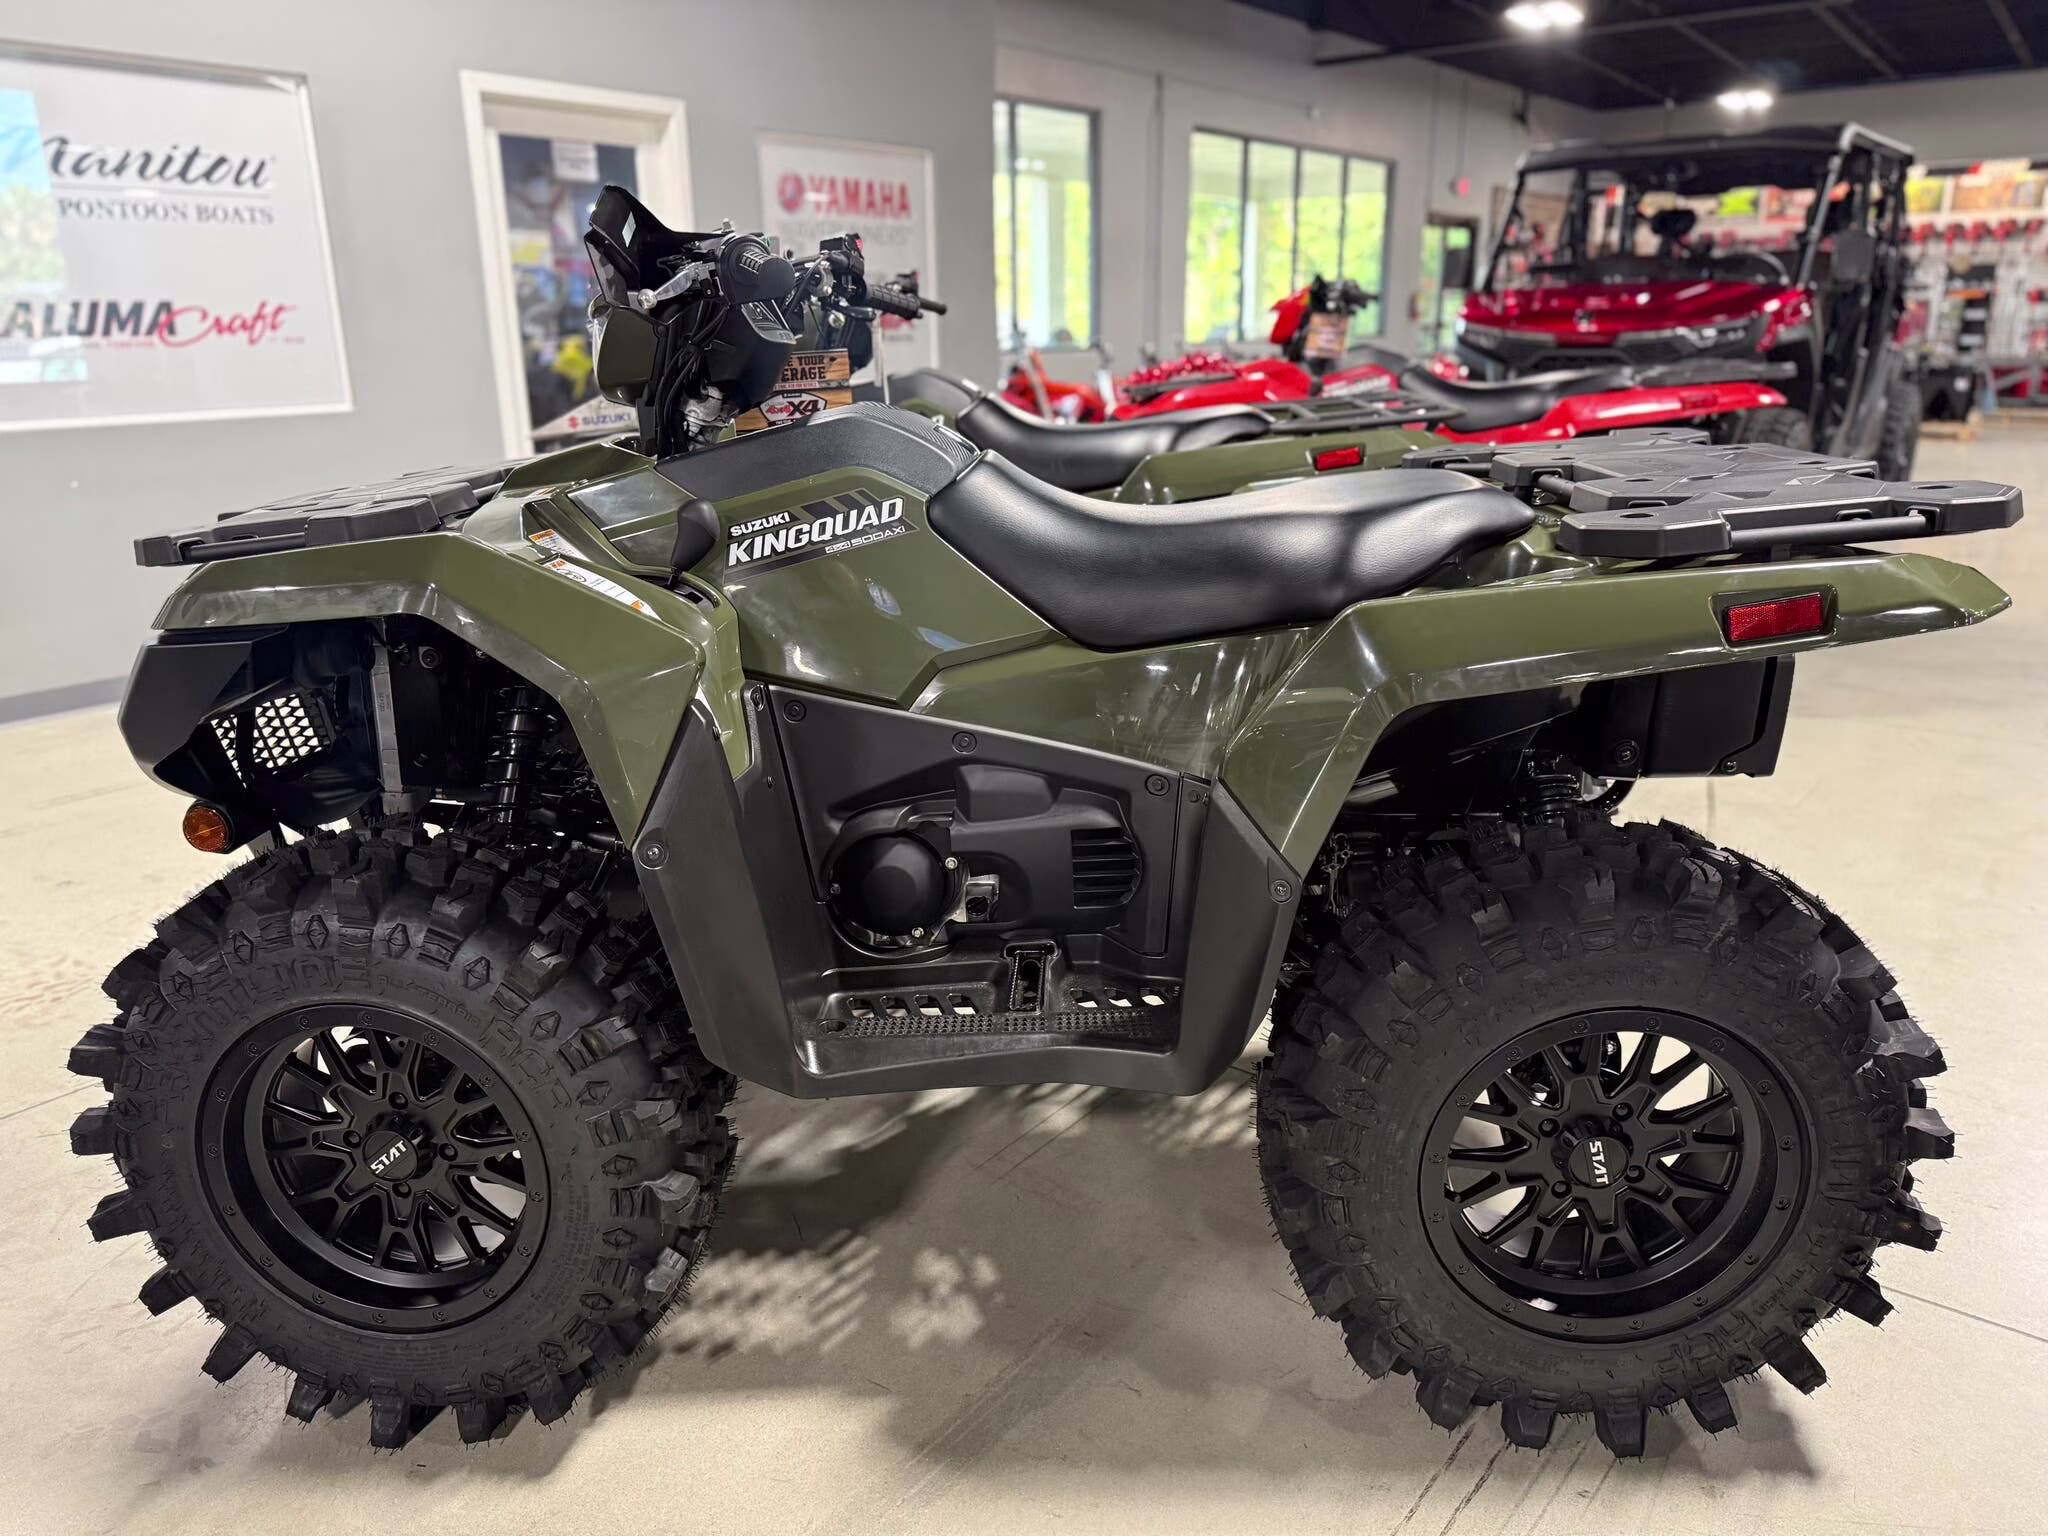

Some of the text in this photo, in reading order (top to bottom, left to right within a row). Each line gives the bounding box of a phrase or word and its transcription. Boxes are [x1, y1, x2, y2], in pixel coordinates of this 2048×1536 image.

[59, 197, 275, 224] PONTOON BOATS
[806, 176, 911, 218] YAMAHA
[798, 355, 825, 367] YOUR
[582, 413, 631, 426] SUZUKI
[728, 497, 904, 567] KINGQUAD
[730, 511, 791, 537] SUZUKI
[370, 1140, 407, 1174] STAT
[1588, 1140, 1609, 1184] STAT
